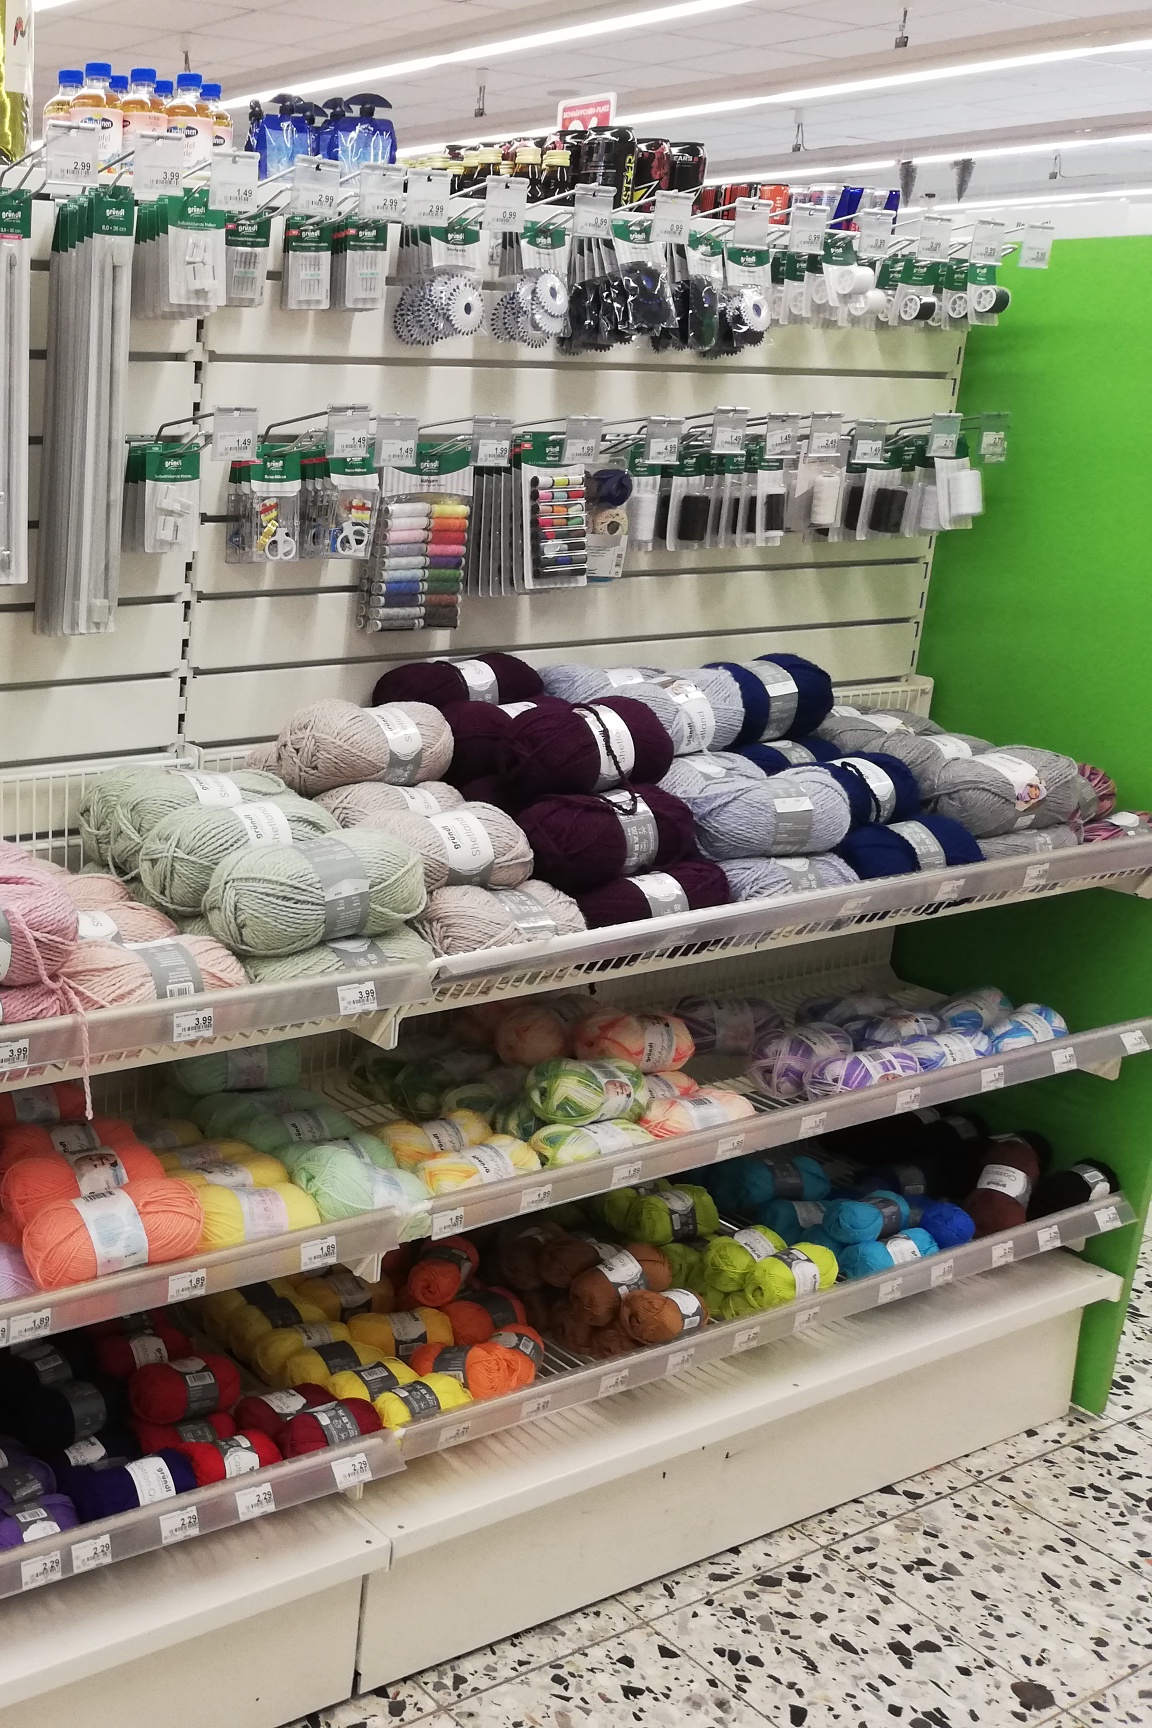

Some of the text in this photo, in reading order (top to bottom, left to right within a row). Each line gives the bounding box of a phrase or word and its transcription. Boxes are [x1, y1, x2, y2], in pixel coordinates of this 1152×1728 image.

[73, 162, 91, 171] 2.99
[162, 171, 180, 180] 3.99
[237, 189, 252, 197] 1.49
[106, 208, 125, 218] gründl
[188, 206, 206, 214] gründl
[1, 211, 21, 220] gründl
[239, 224, 258, 233] gründl
[302, 230, 320, 239] gründl
[359, 230, 376, 238] gründl
[236, 437, 252, 447] 1.49
[352, 436, 366, 445] 1.49
[729, 434, 742, 443] 1.49
[399, 447, 414, 455] 1.49
[494, 446, 508, 455] 1.99
[581, 445, 595, 454] 1.99
[165, 459, 182, 468] gründl
[267, 461, 284, 469] gründl
[420, 461, 440, 470] gründl
[245, 814, 262, 839] gründl
[441, 824, 461, 851] gründl
[455, 816, 481, 858] Shetland
[358, 988, 375, 998] 3.99
[195, 1015, 212, 1025] 3.99
[9, 1047, 28, 1057] 3.99
[290, 1121, 303, 1141] ründl
[432, 1132, 445, 1151] ründl
[320, 1244, 336, 1254] 1.89
[188, 1276, 205, 1287] 1.89
[32, 1316, 50, 1327] 1.89
[352, 1460, 368, 1471] 2.29
[156, 1467, 173, 1493] gründl
[256, 1491, 272, 1502] 2.29
[180, 1514, 197, 1526] 2.29
[93, 1543, 110, 1555] 2.29
[42, 1558, 60, 1571] 2.29
